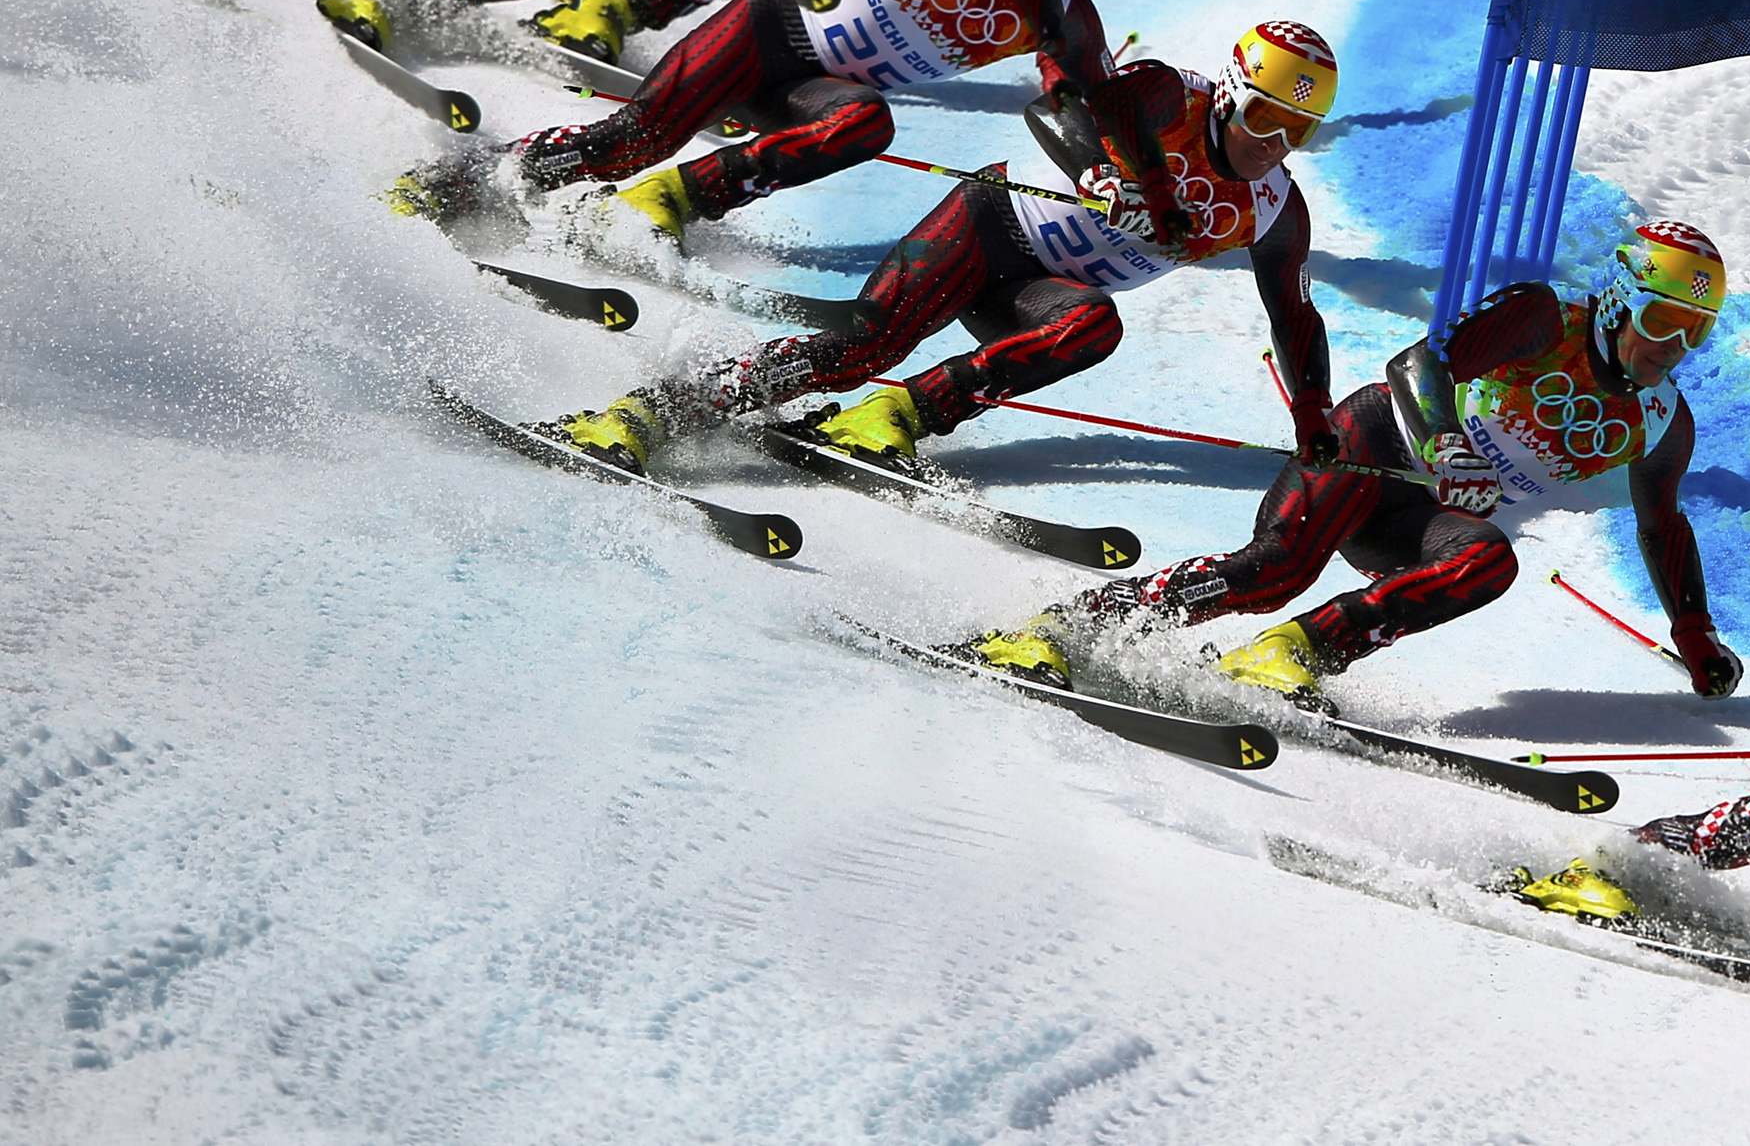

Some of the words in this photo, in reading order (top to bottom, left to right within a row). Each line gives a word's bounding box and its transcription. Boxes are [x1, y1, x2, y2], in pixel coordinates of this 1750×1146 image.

[902, 51, 944, 79] 2014
[1038, 215, 1130, 288] 25
[1122, 247, 1161, 275] 2014
[1464, 415, 1514, 474] SOCHI
[1508, 472, 1548, 496] 2014
